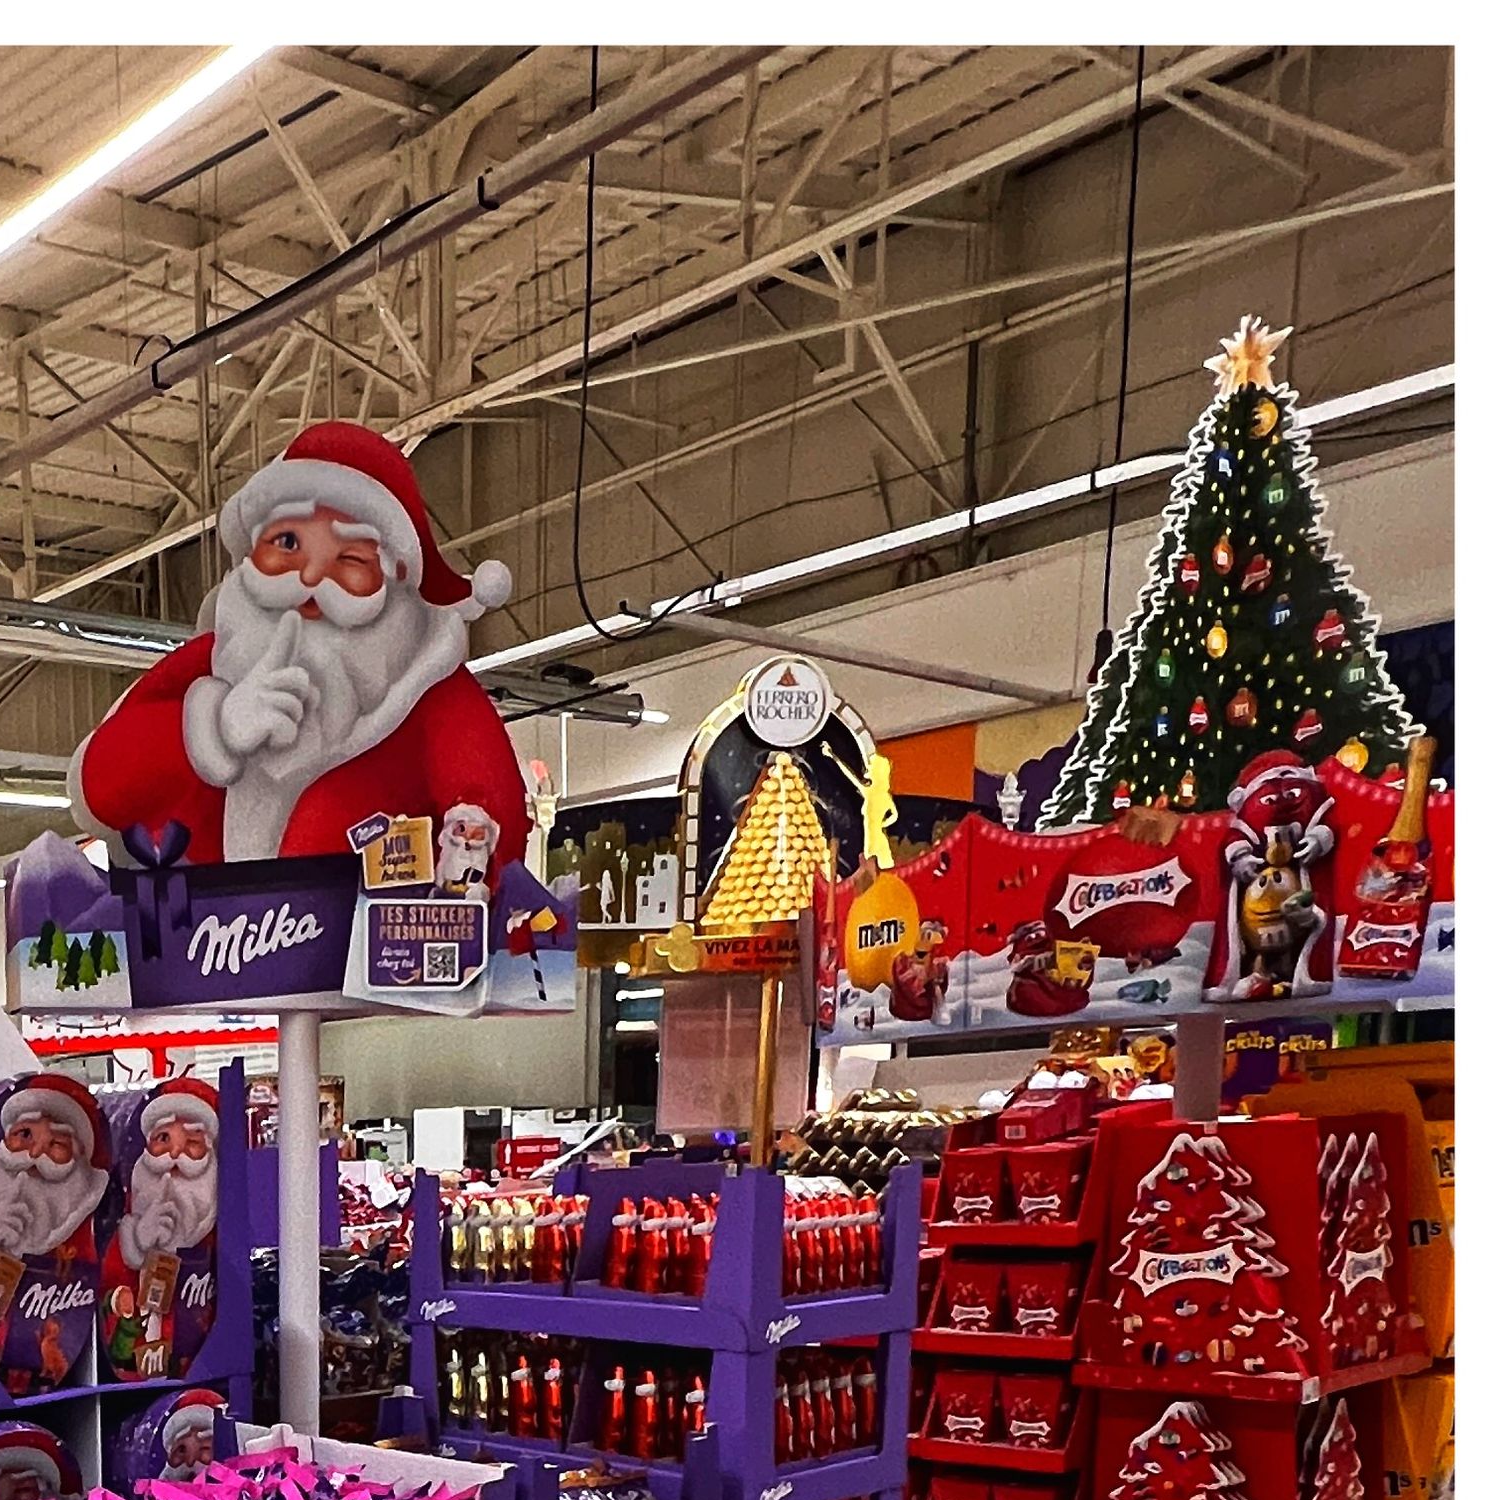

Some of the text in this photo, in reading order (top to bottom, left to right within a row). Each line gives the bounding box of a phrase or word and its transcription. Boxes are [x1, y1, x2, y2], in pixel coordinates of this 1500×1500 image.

[757, 690, 818, 704] FERRERO
[756, 704, 816, 720] ROCHER
[380, 906, 475, 923] TES STICKERS
[187, 903, 324, 975] Milka
[19, 1280, 95, 1320] Milka
